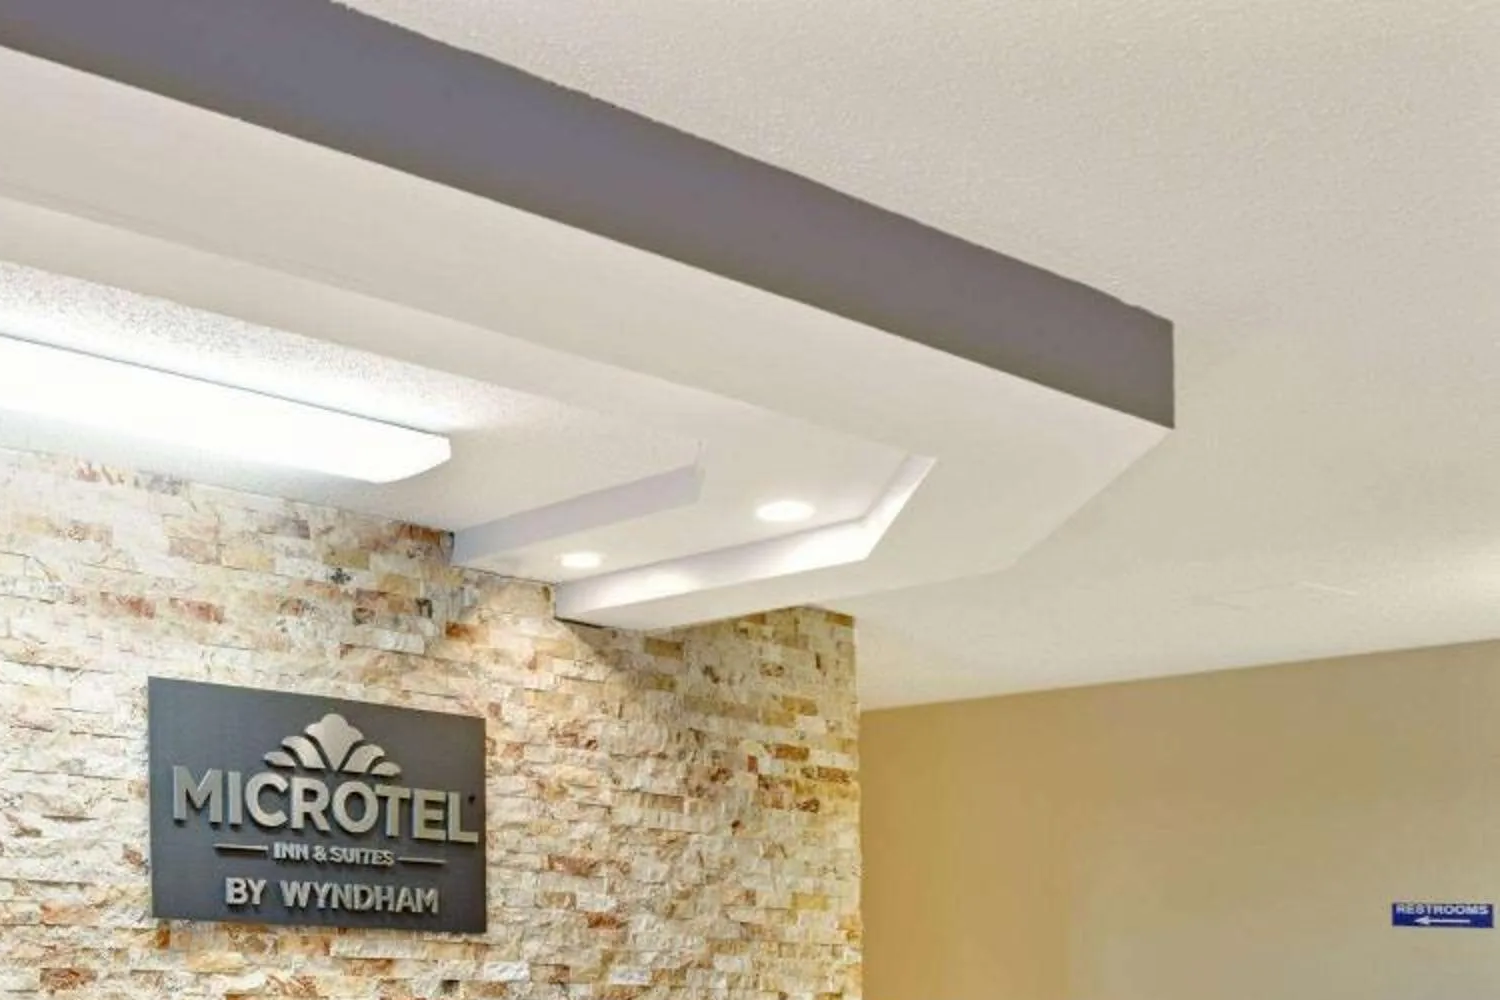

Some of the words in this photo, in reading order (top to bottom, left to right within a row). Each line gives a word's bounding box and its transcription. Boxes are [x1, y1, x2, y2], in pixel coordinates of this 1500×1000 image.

[173, 765, 479, 843] MICROTEL
[273, 841, 309, 860] INN
[312, 845, 327, 862] &
[330, 845, 395, 866] SUITES
[225, 877, 267, 905] BY
[279, 879, 439, 914] WYNDHAM
[1395, 904, 1489, 915] RESTROOMS
